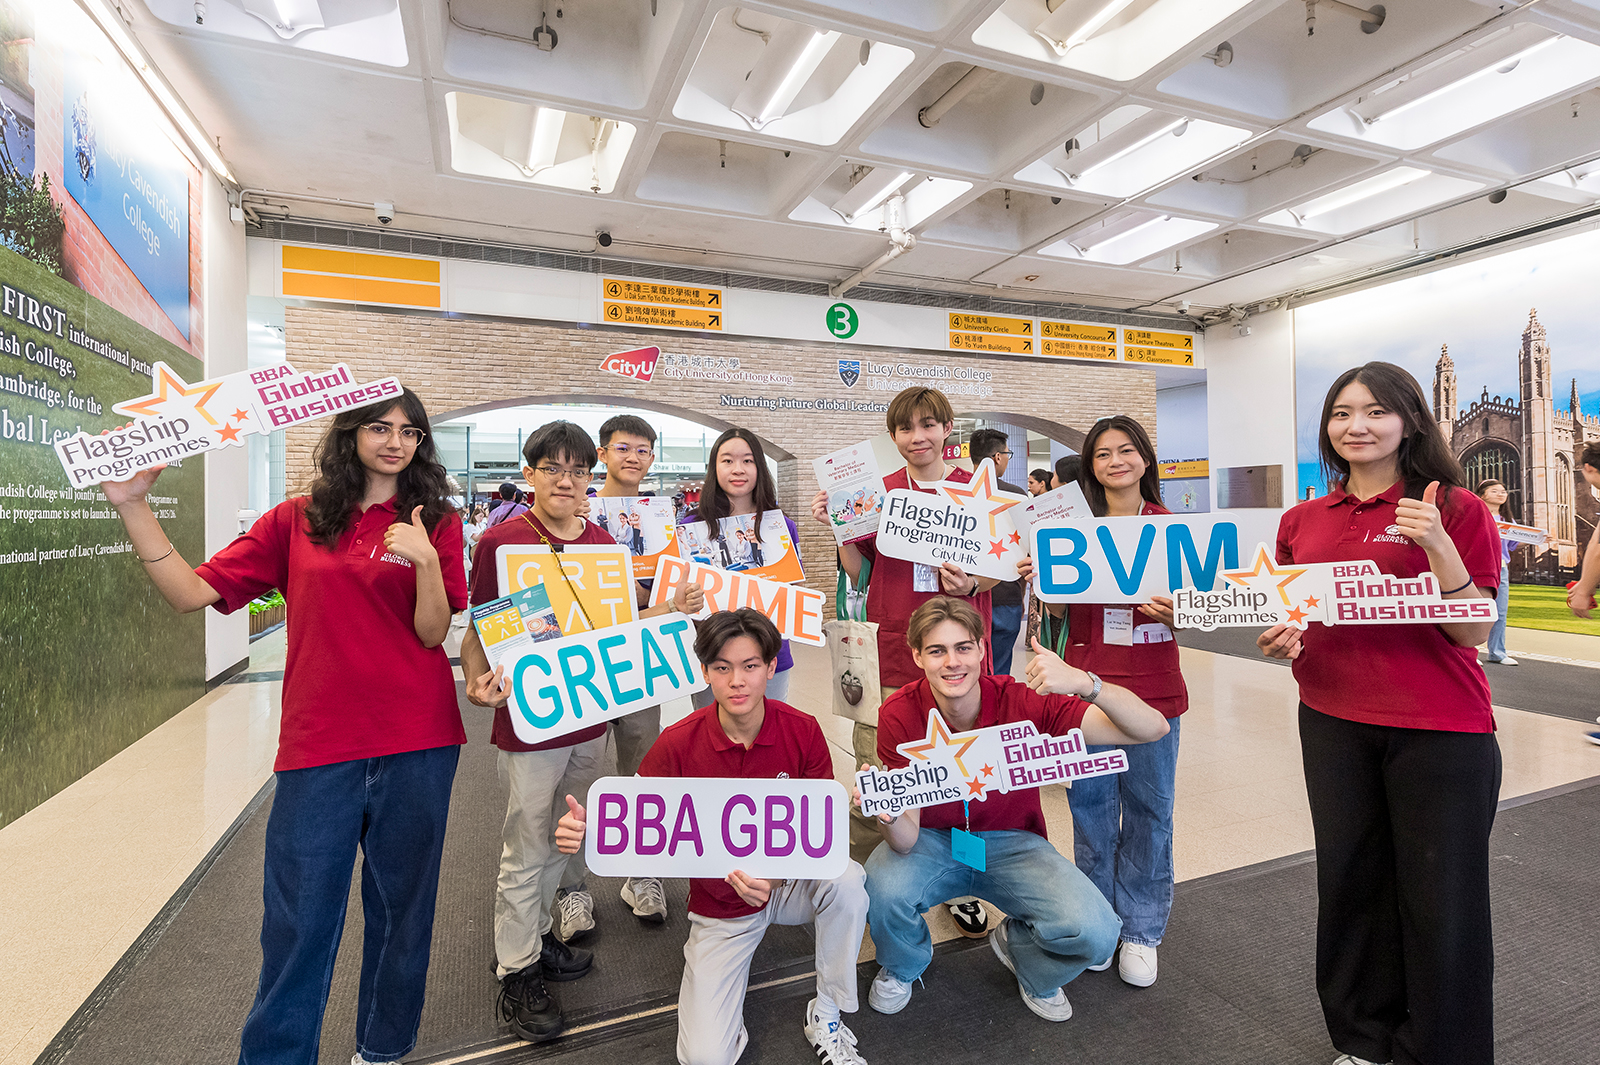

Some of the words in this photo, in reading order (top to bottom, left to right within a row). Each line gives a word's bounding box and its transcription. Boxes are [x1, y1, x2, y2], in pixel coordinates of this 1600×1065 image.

[128, 158, 181, 239] Cavendish
[123, 192, 161, 257] College
[671, 296, 689, 304] Academic
[690, 298, 706, 307] Building
[2, 285, 67, 338] FIRST
[69, 324, 130, 367] international
[131, 357, 154, 377] partne
[636, 316, 649, 324] Ming
[660, 317, 685, 327] Academic
[685, 319, 706, 329] Building
[833, 306, 852, 336] 3
[964, 323, 992, 333] University
[993, 325, 1009, 333] Circle
[988, 344, 1012, 352] Building
[1054, 331, 1079, 340] University
[1080, 333, 1106, 341] Concourse
[0, 330, 21, 357] ish
[25, 340, 77, 378] College,
[664, 355, 741, 370] 香港城市大學
[249, 365, 293, 385] BBA
[607, 359, 654, 379] CityU
[664, 368, 684, 380] City
[685, 369, 732, 382] University
[733, 370, 744, 380] of
[745, 372, 769, 384] Hong
[769, 373, 793, 385] Kong
[867, 361, 894, 378] Lucy
[896, 363, 951, 379] Cavendish
[953, 367, 992, 383] College
[0, 374, 65, 408] ambridge,
[68, 390, 85, 411] for
[87, 396, 102, 415] the
[257, 366, 350, 406] Global
[936, 380, 994, 399] Cambridge
[267, 380, 399, 427] Business
[721, 395, 777, 411] Nurturing
[778, 398, 813, 409] Future
[815, 399, 849, 411] Global
[2, 409, 34, 443] bal
[40, 418, 81, 445] Lea
[61, 415, 190, 465] Flagship
[72, 435, 211, 484] Programmes
[671, 464, 692, 472] Library
[0, 483, 25, 497] ndish
[27, 484, 58, 503] College
[60, 486, 73, 499] will
[74, 488, 95, 504] jointly
[148, 493, 172, 507] Programme
[0, 505, 11, 519] he
[13, 508, 62, 524] programme
[63, 506, 70, 519] is
[71, 509, 80, 519] set
[82, 508, 89, 519] to
[90, 507, 110, 519] launch
[888, 496, 978, 536] Flagship
[885, 521, 982, 553] Programmes
[0, 547, 37, 565] national
[39, 548, 69, 565] partner
[69, 544, 78, 557] of
[78, 544, 94, 559] Lucy
[95, 543, 125, 555] Cavendish
[125, 541, 133, 552] for
[380, 556, 411, 568] BUSINESS
[931, 547, 978, 566] CityUHK
[1036, 521, 1240, 596] BVM
[1332, 564, 1375, 578] BBA
[1176, 587, 1268, 612] Flagship
[1334, 577, 1434, 599] Global
[655, 559, 822, 642] PRIME
[1337, 601, 1492, 621] Business
[1178, 611, 1279, 627] Programmes
[513, 619, 696, 730] GREAT
[1000, 725, 1035, 742] BBA
[1003, 733, 1082, 765] Global
[859, 761, 948, 795] Flagship
[1008, 754, 1125, 787] Business
[864, 786, 961, 813] Programmes
[597, 793, 704, 857] BBA
[720, 793, 833, 859] GBU
